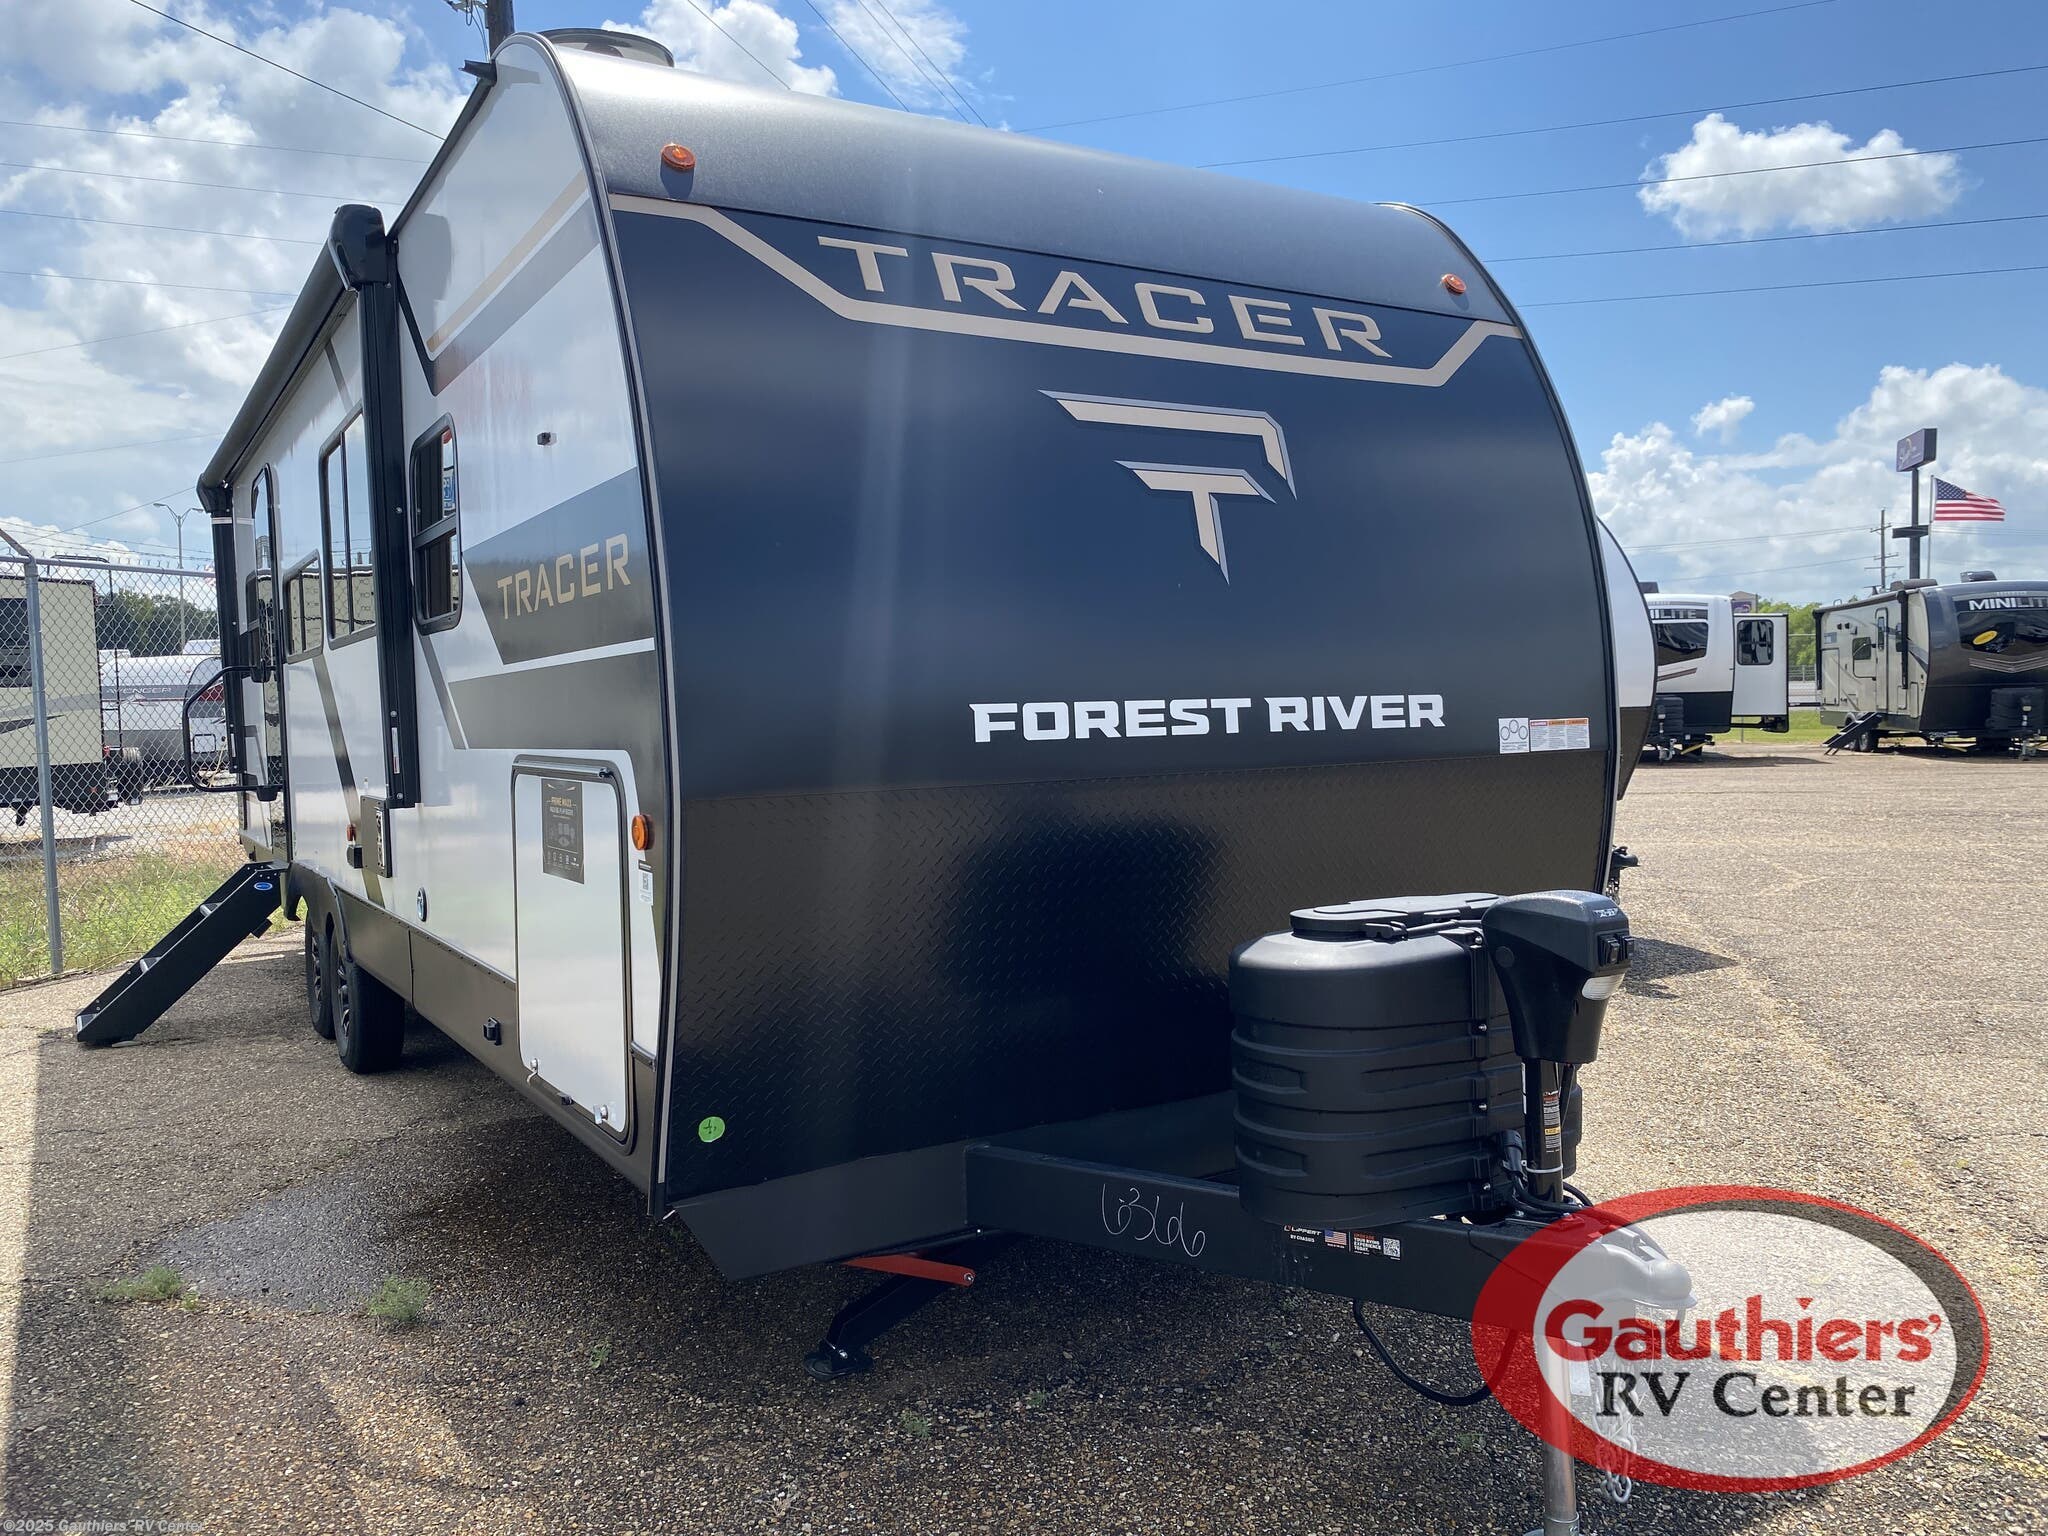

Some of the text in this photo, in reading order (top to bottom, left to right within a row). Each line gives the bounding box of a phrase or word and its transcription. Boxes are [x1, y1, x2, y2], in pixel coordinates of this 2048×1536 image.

[817, 236, 1392, 358] TRACER
[497, 533, 631, 620] TRACER
[969, 694, 1446, 743] FOREST RIVER
